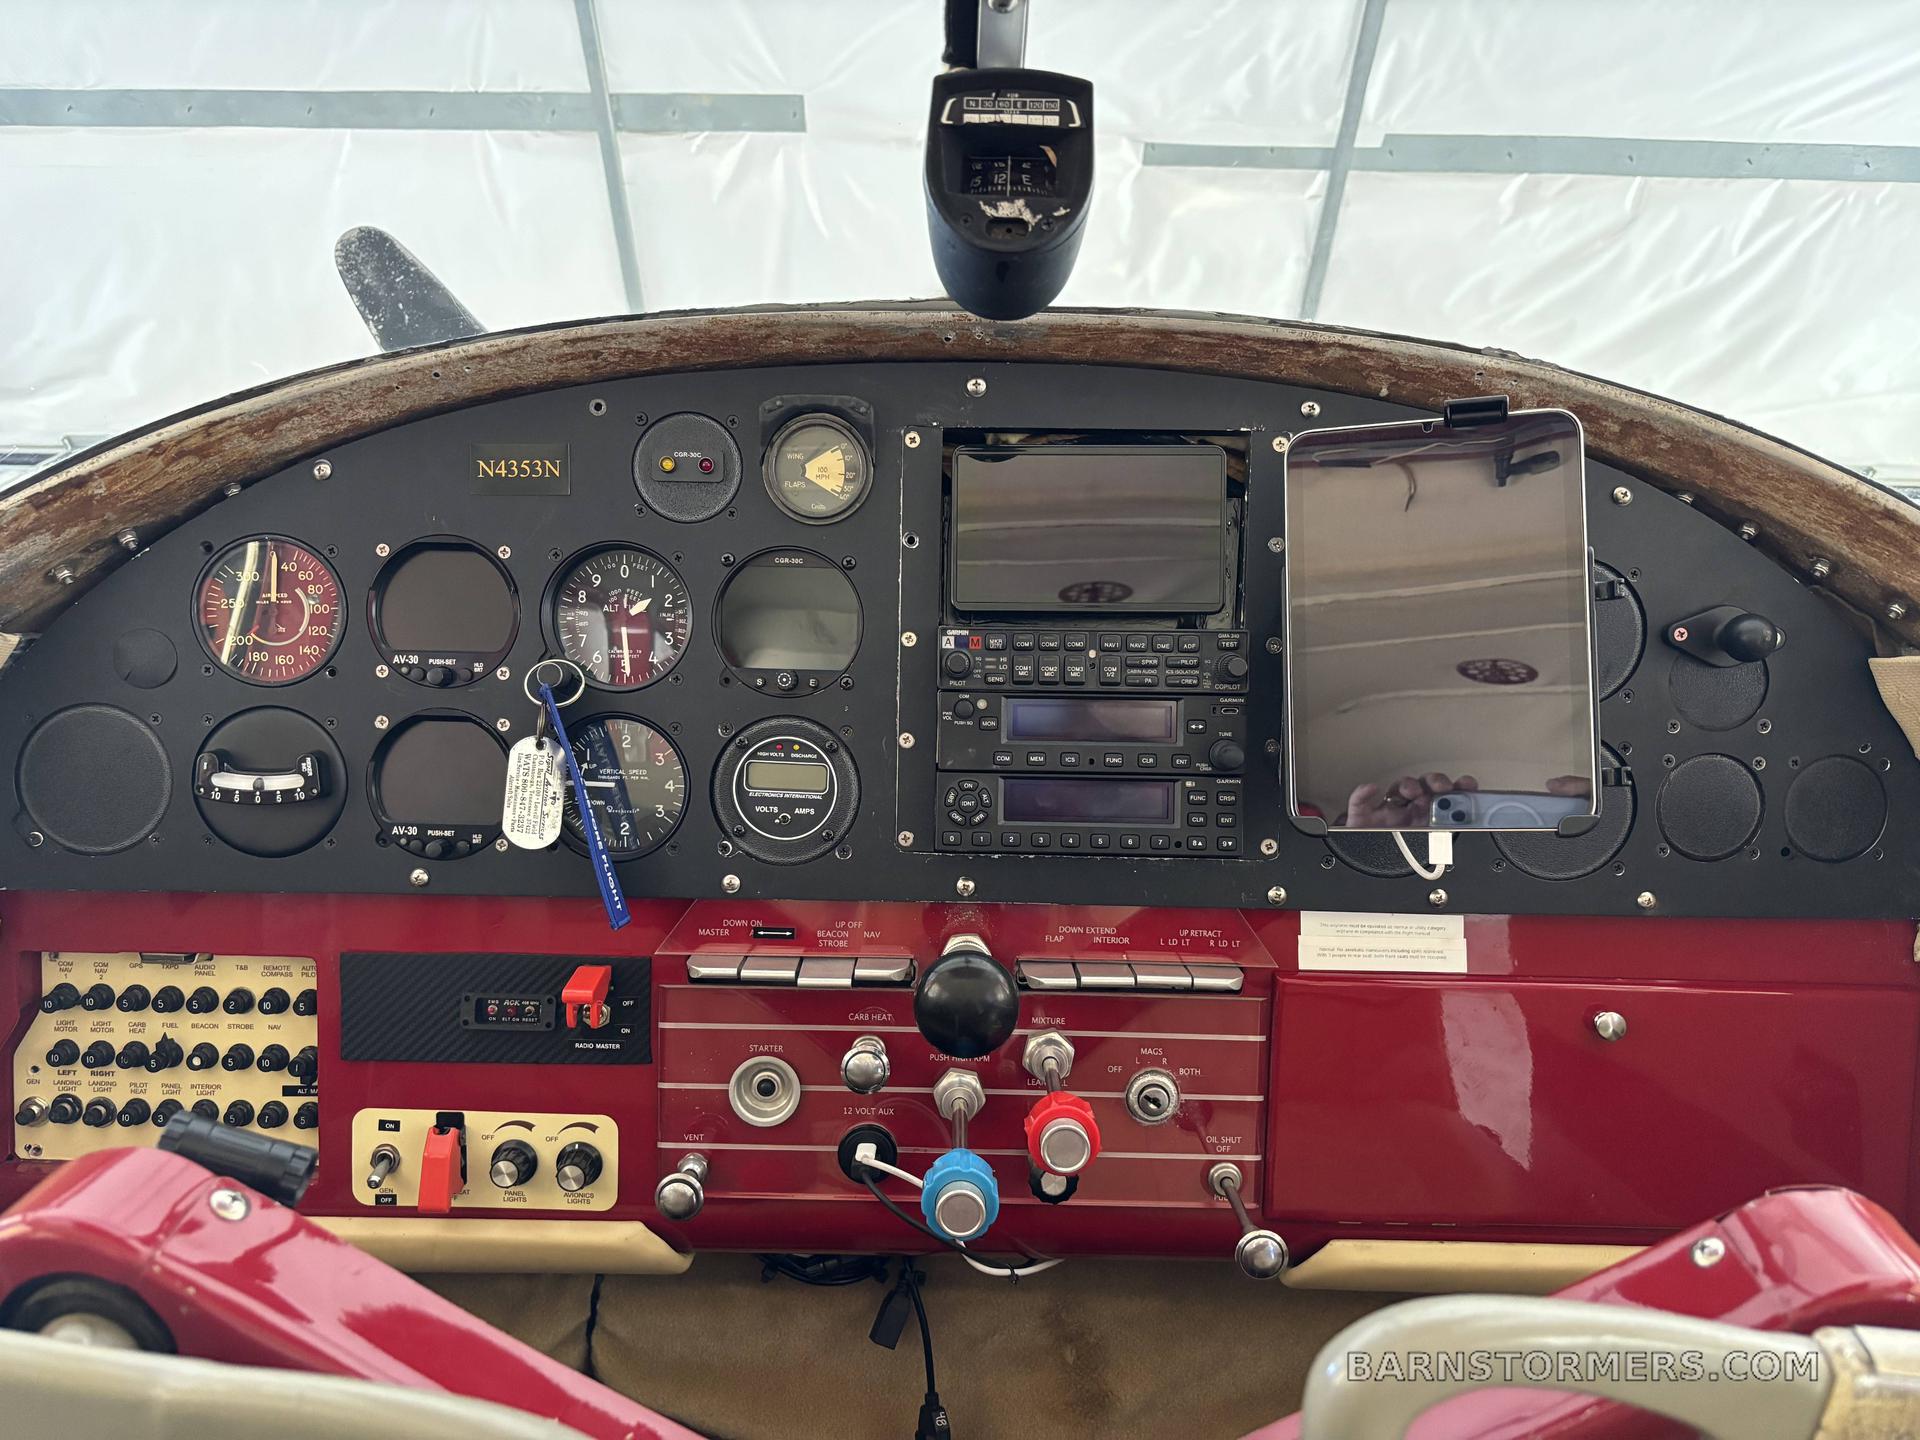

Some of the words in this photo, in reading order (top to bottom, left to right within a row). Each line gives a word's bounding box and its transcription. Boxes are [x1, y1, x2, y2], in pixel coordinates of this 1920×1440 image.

[477, 460, 560, 479] N4353N
[281, 562, 297, 571] 40
[299, 571, 313, 581] 60
[308, 585, 323, 594] 80
[578, 591, 586, 603] 8
[665, 594, 672, 607] 2
[310, 604, 330, 614] 100
[309, 626, 327, 636] 120
[579, 634, 586, 647] 7
[665, 632, 673, 645] 3
[299, 646, 319, 655] 140
[275, 655, 294, 665] 160
[393, 655, 418, 664] AV-30
[593, 651, 601, 663] 6
[649, 651, 658, 664] 4
[622, 735, 631, 747] 2
[522, 753, 531, 777] WATS
[545, 752, 553, 775] Signal
[656, 753, 664, 765] 3
[665, 780, 675, 792] 4
[211, 791, 221, 800] 10
[295, 791, 305, 800] 10
[543, 778, 552, 807] Aviation
[517, 779, 528, 833] 800-847-3237
[655, 805, 664, 817] 3
[392, 826, 417, 835] AV-30
[539, 811, 548, 840] Services
[620, 823, 630, 835] 2
[602, 854, 622, 911] FLIGHT
[1031, 1017, 1065, 1025] MIXTURE
